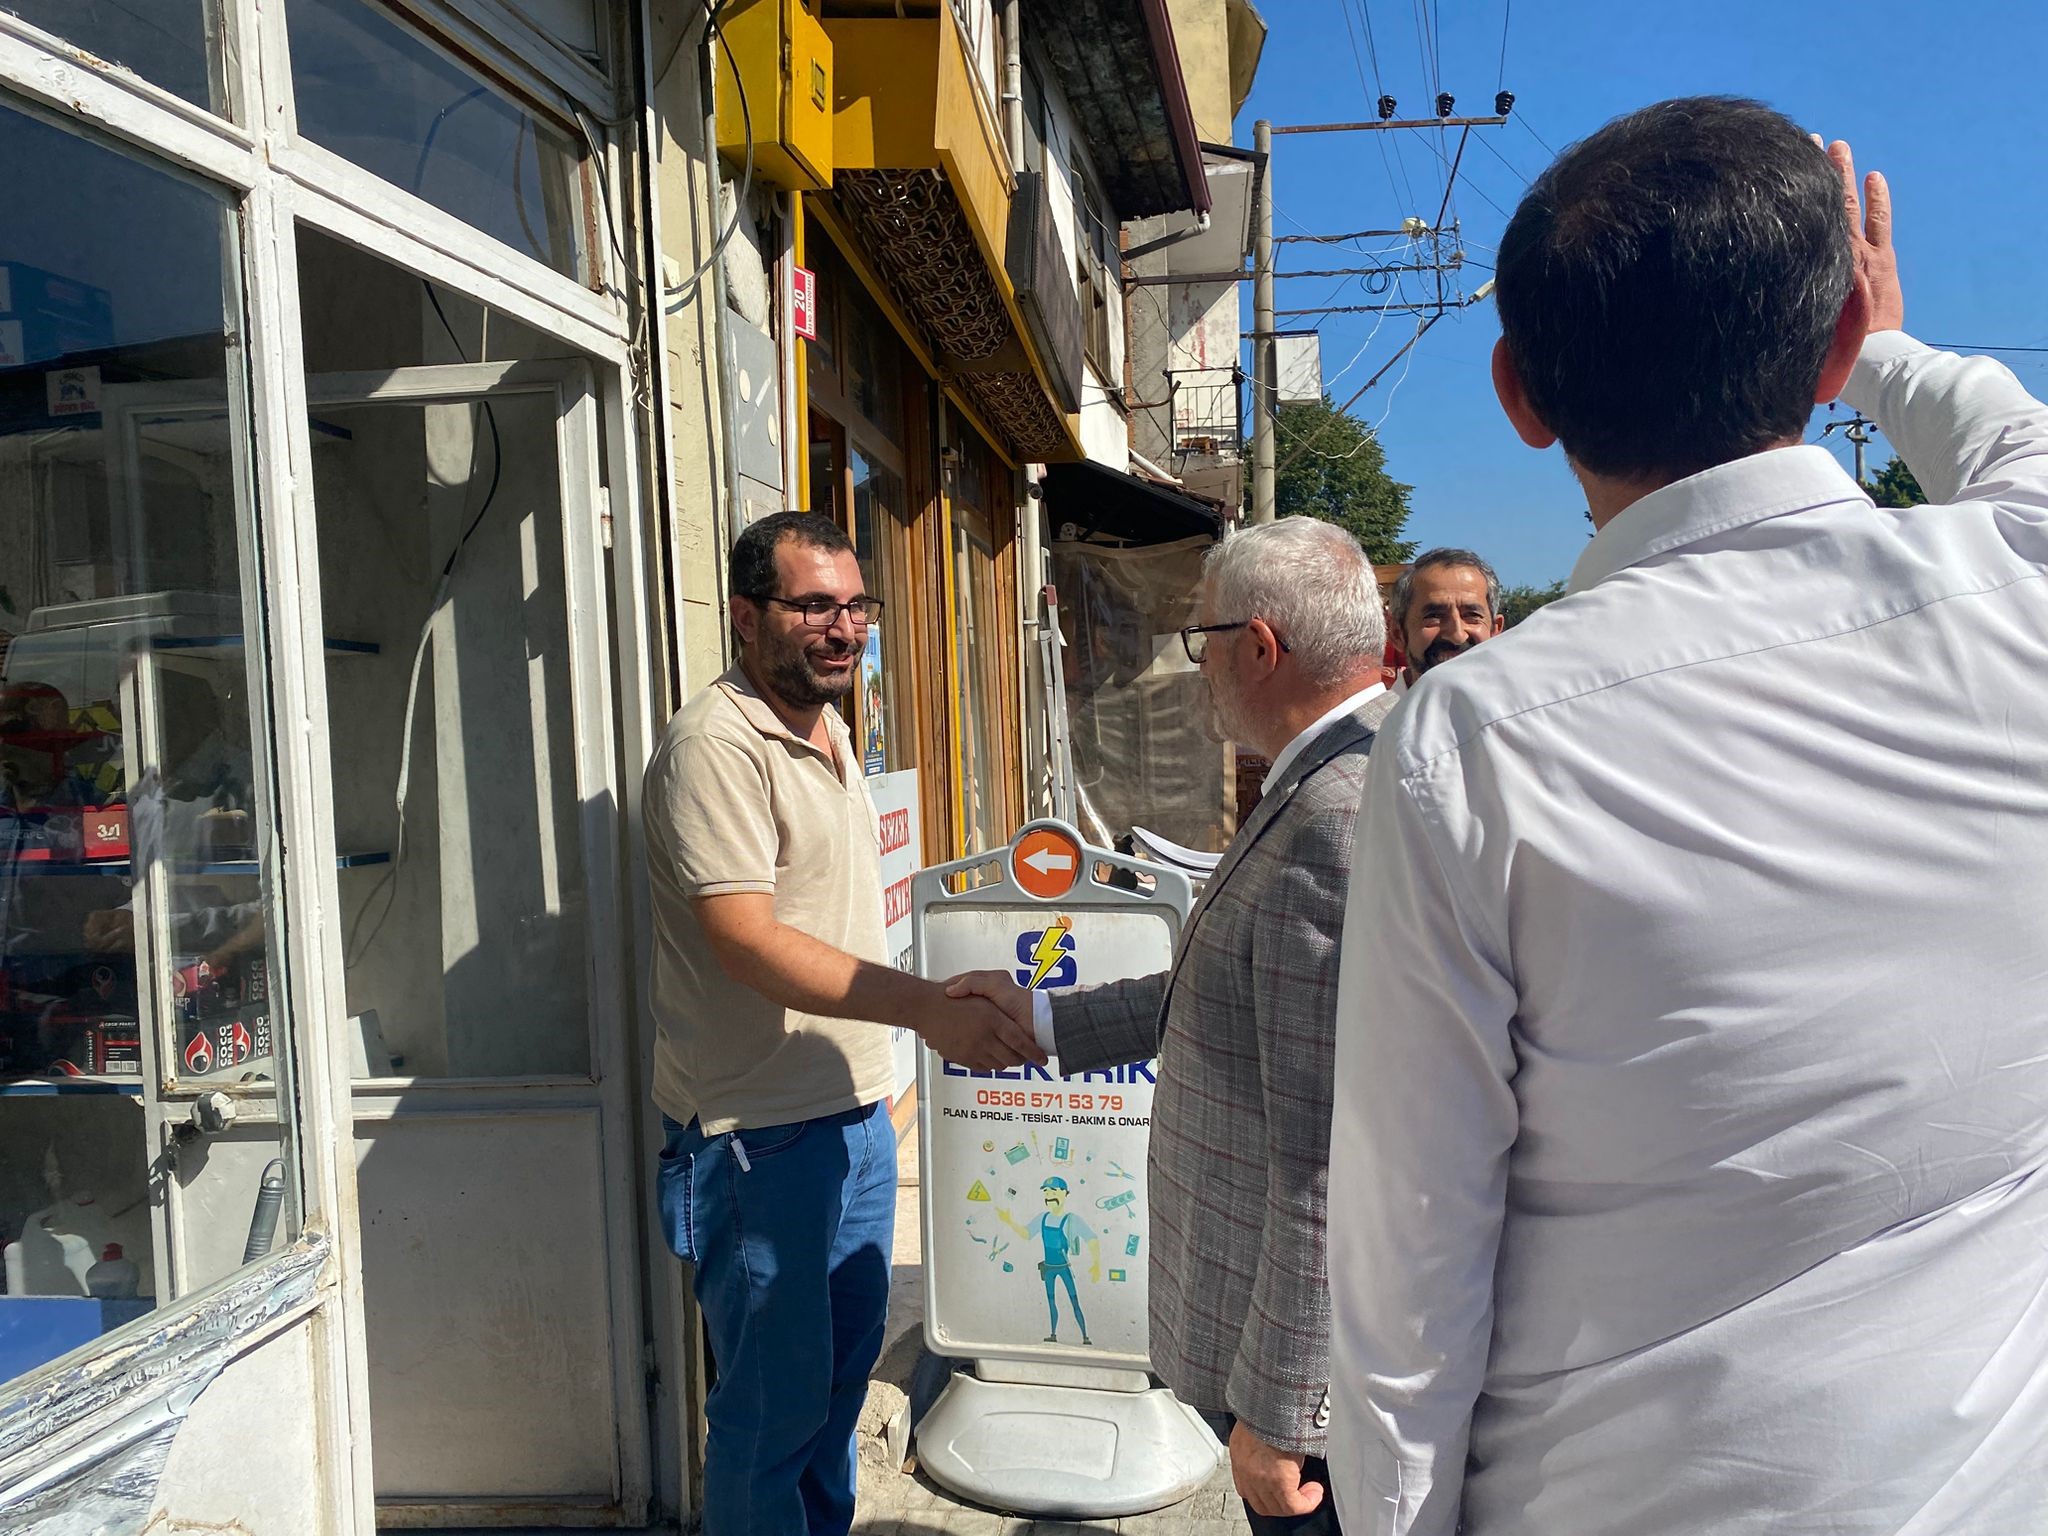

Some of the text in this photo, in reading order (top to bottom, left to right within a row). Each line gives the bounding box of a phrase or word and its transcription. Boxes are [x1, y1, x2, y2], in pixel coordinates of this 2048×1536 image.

[794, 289, 805, 313] 20
[879, 808, 910, 857] SEZER
[884, 868, 916, 929] EKTR
[219, 1026, 228, 1067] COCO
[256, 1016, 265, 1056] COCO
[943, 1107, 968, 1119] PLAN
[970, 1110, 978, 1119] &
[980, 1111, 1013, 1122] PROJE
[1021, 1111, 1063, 1124] TESİSAT
[1071, 1115, 1106, 1126] BAKIM
[1108, 1116, 1116, 1126] &
[1118, 1117, 1150, 1127] ONAR
[976, 1090, 1123, 1111] 0536 571 53 79
